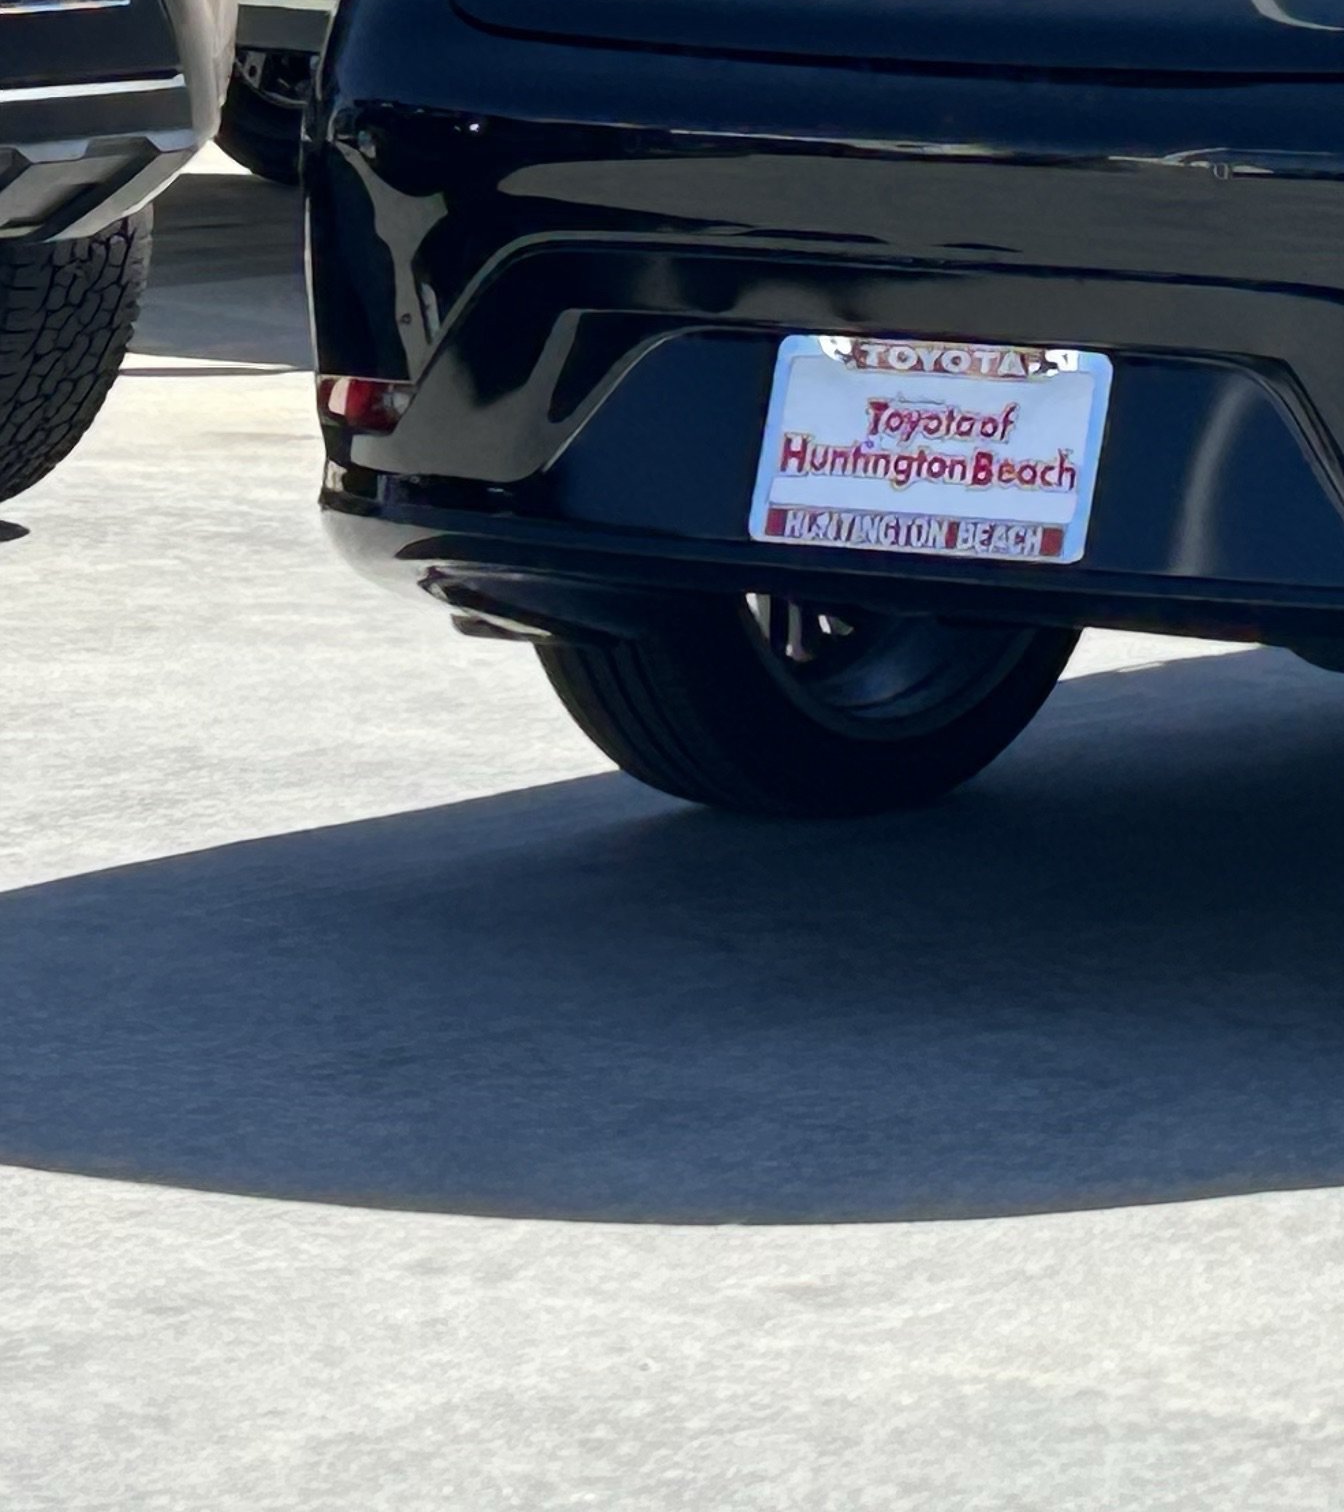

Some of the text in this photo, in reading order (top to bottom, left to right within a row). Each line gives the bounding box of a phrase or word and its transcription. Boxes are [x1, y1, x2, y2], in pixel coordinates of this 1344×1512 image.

[860, 342, 1027, 376] TOYOTA
[867, 399, 1018, 443] Toyota of
[779, 434, 1078, 491] Huntington Beach
[783, 508, 1044, 556] HUNTINGTON BEACH
